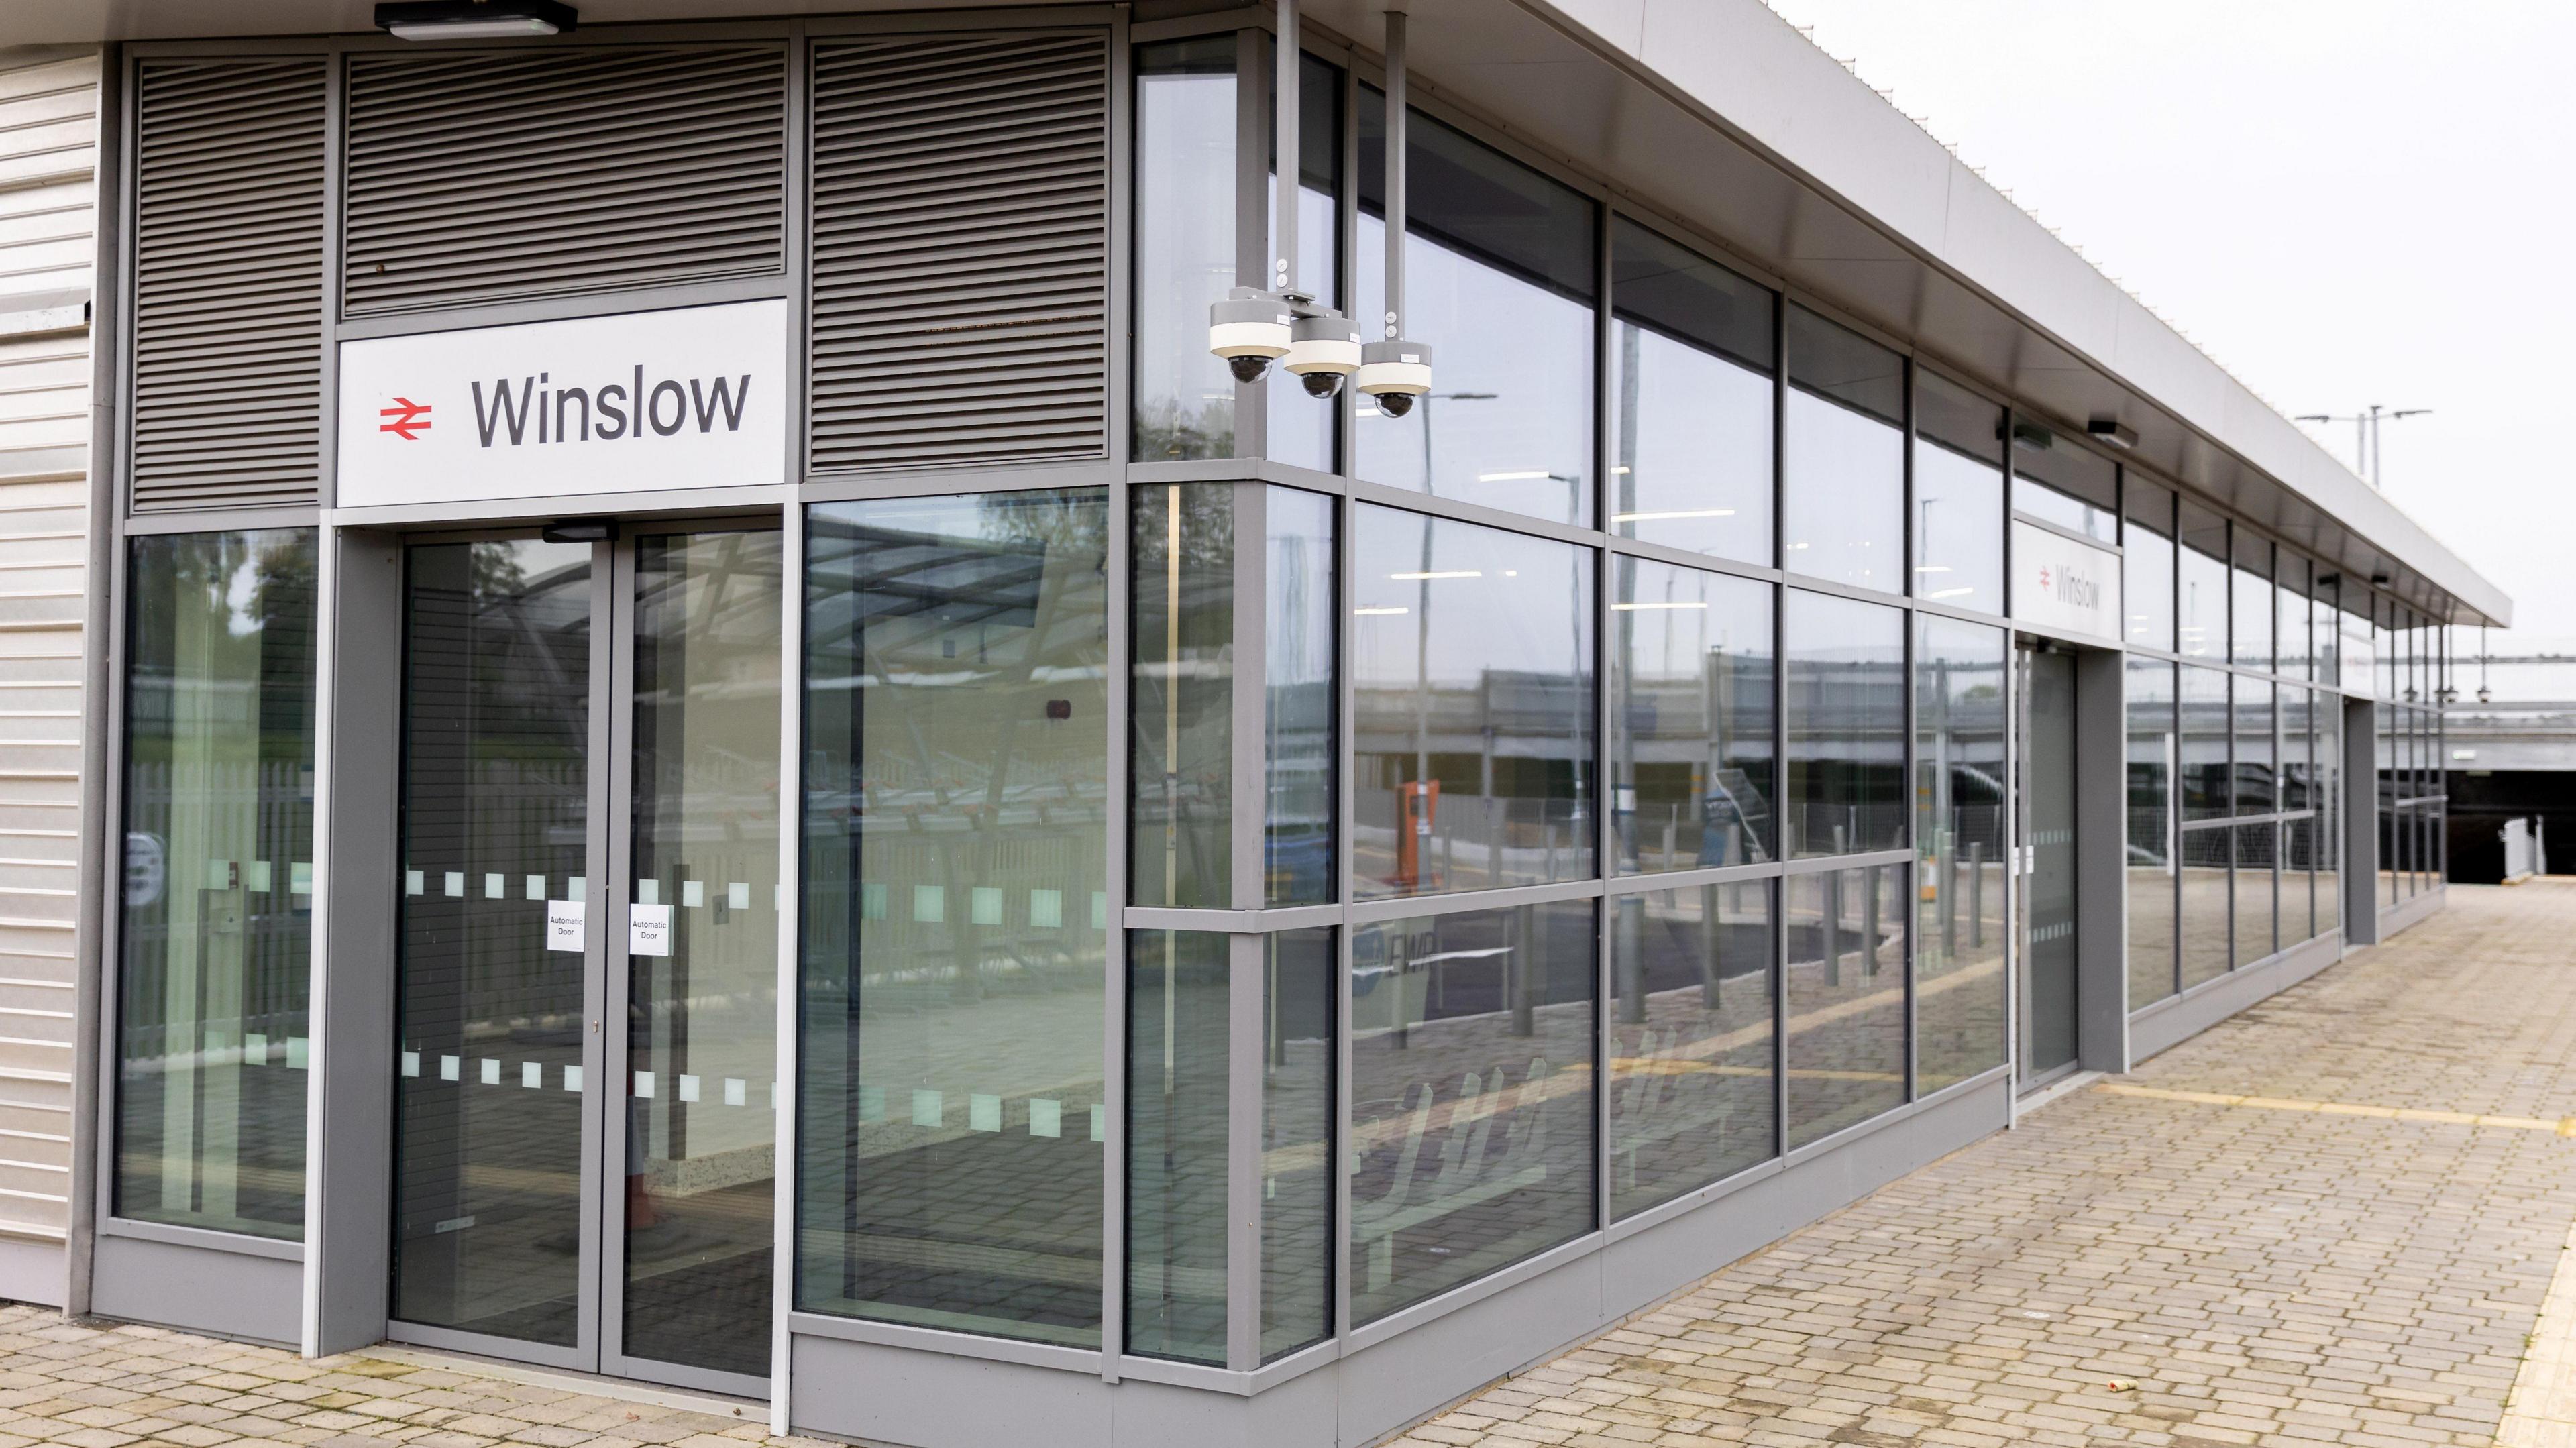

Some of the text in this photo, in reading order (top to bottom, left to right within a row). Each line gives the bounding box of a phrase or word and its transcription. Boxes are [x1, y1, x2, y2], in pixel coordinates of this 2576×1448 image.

[471, 364, 751, 448] Winslow
[2055, 564, 2100, 610] Winslow
[550, 916, 583, 926] Automatic
[633, 920, 667, 929] Automatic
[558, 927, 574, 936] Door
[641, 931, 657, 940] Door
